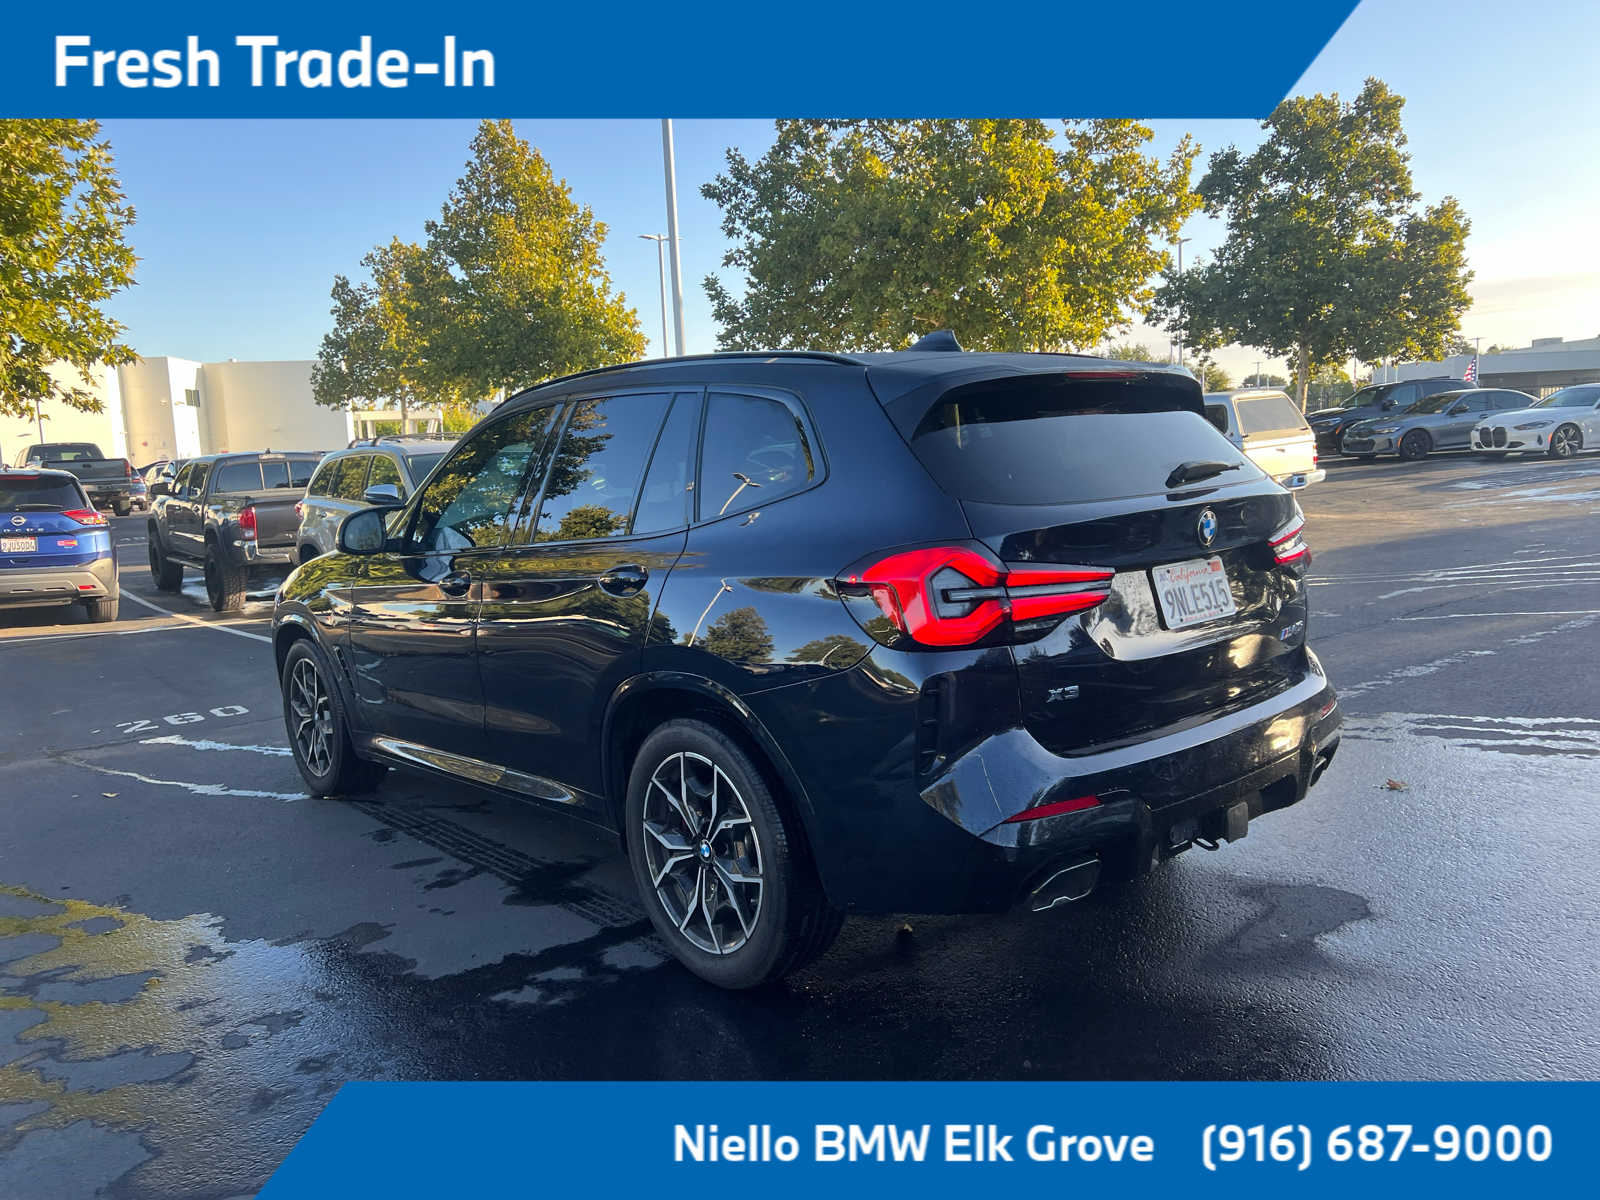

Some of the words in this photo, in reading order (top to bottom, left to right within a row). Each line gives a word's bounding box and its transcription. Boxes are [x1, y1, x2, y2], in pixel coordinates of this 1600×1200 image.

[1164, 579, 1229, 619] 9NLE515
[1046, 685, 1079, 703] X3
[115, 705, 249, 734] 260
